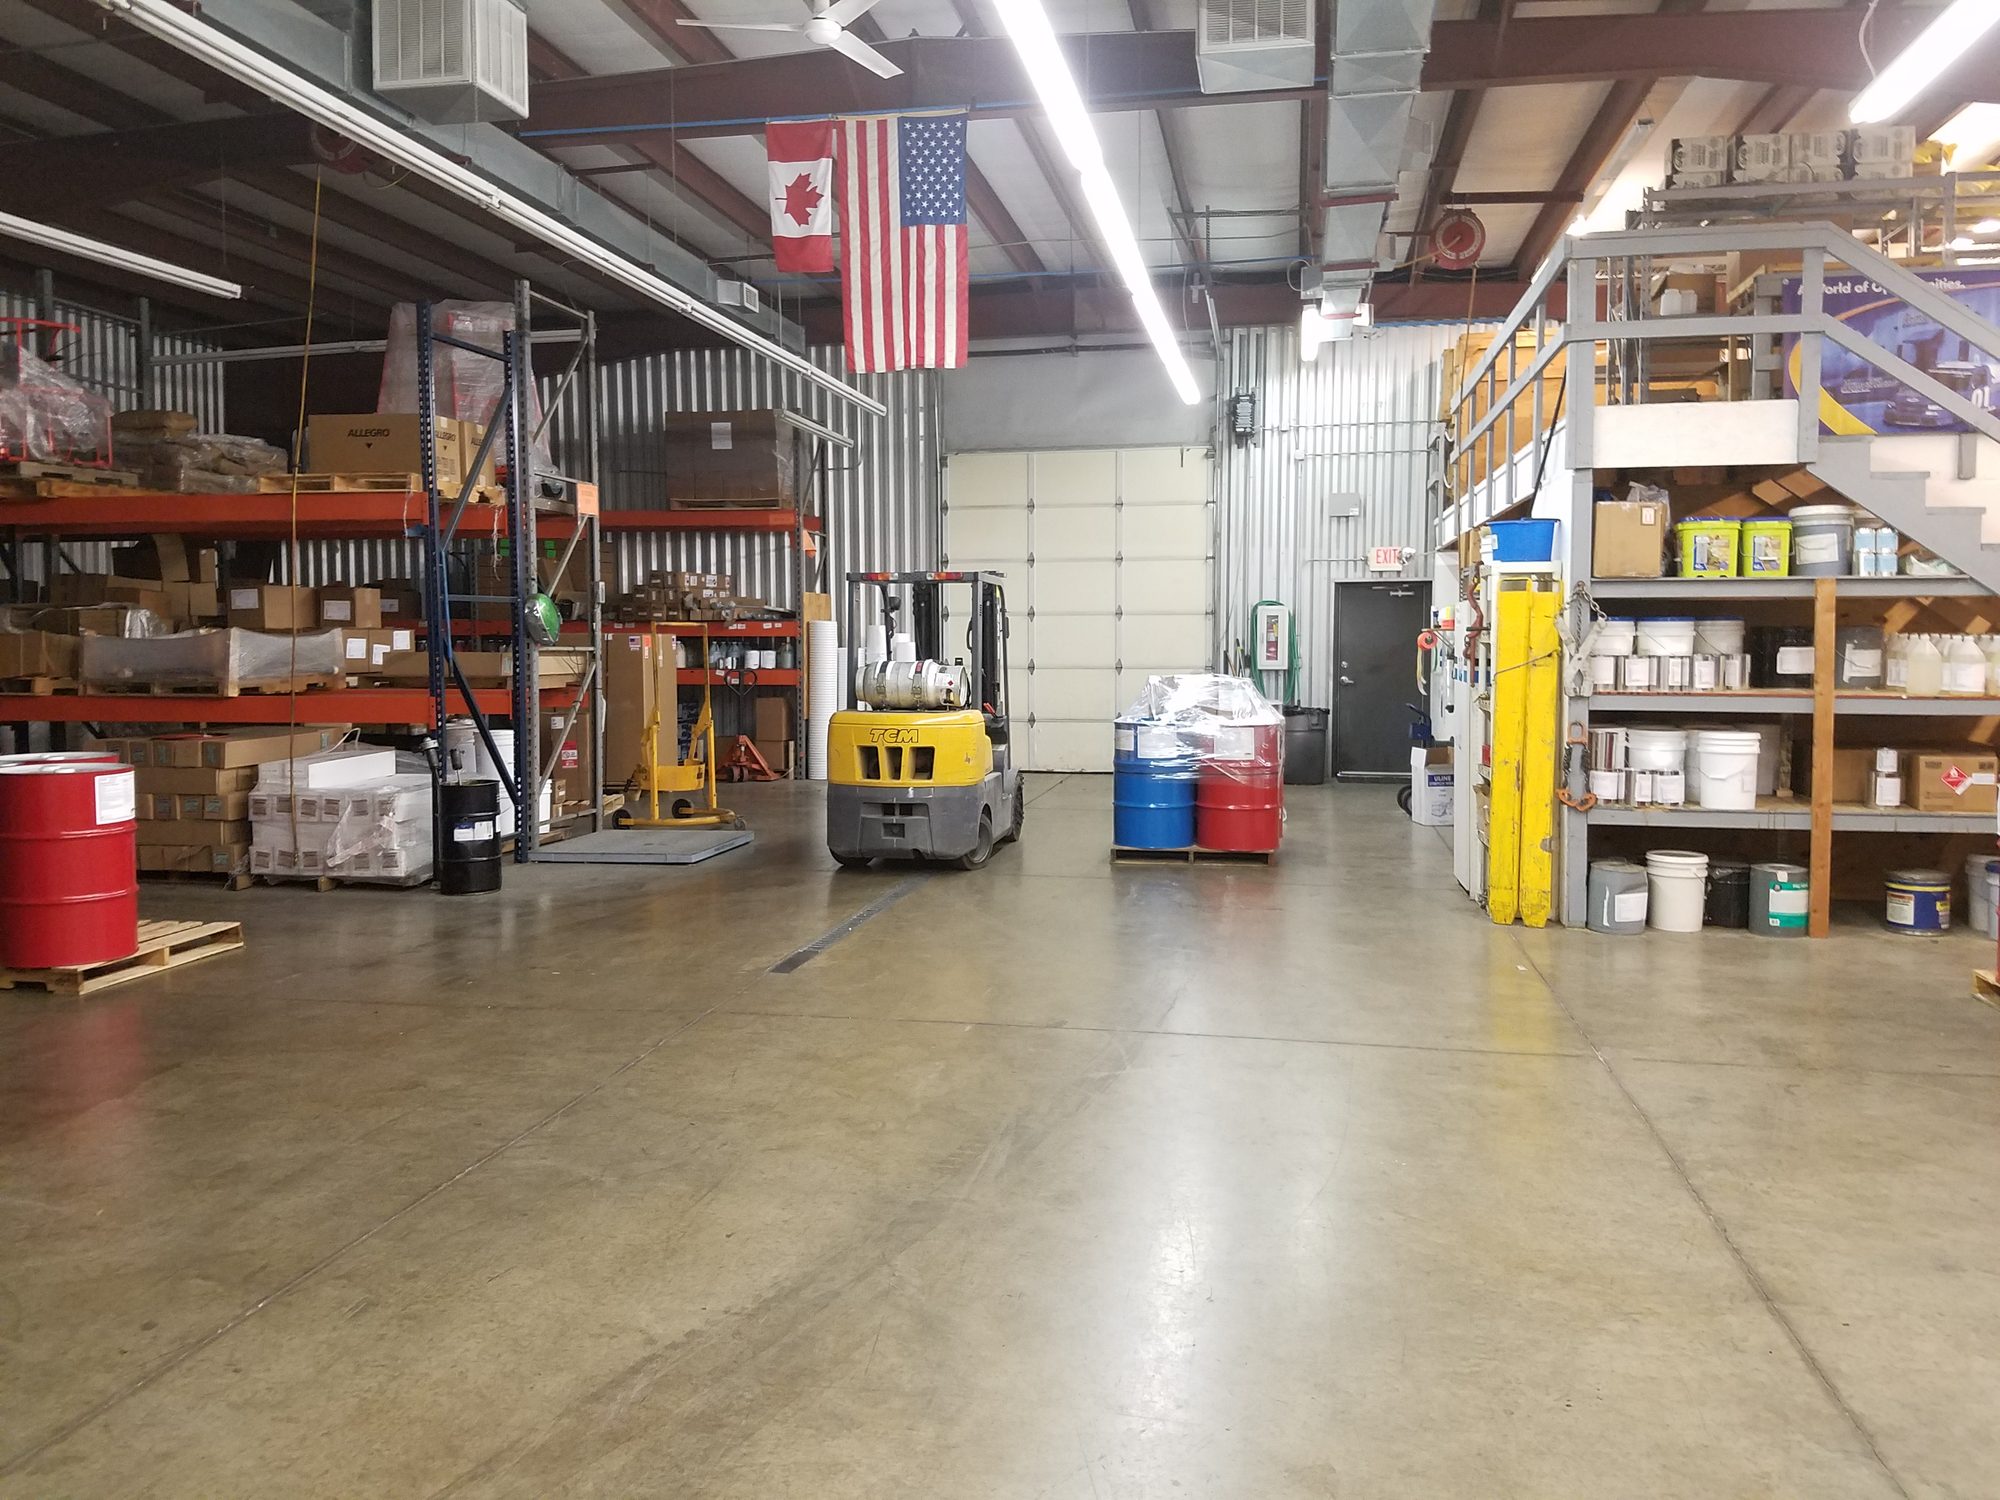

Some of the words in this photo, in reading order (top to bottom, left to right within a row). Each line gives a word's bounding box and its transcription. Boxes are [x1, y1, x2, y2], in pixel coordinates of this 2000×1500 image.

[1822, 280, 1852, 295] orld
[1854, 280, 1870, 294] of
[347, 428, 391, 438] ALLEGRO
[1376, 548, 1399, 564] EXIT
[869, 728, 919, 743] TCM
